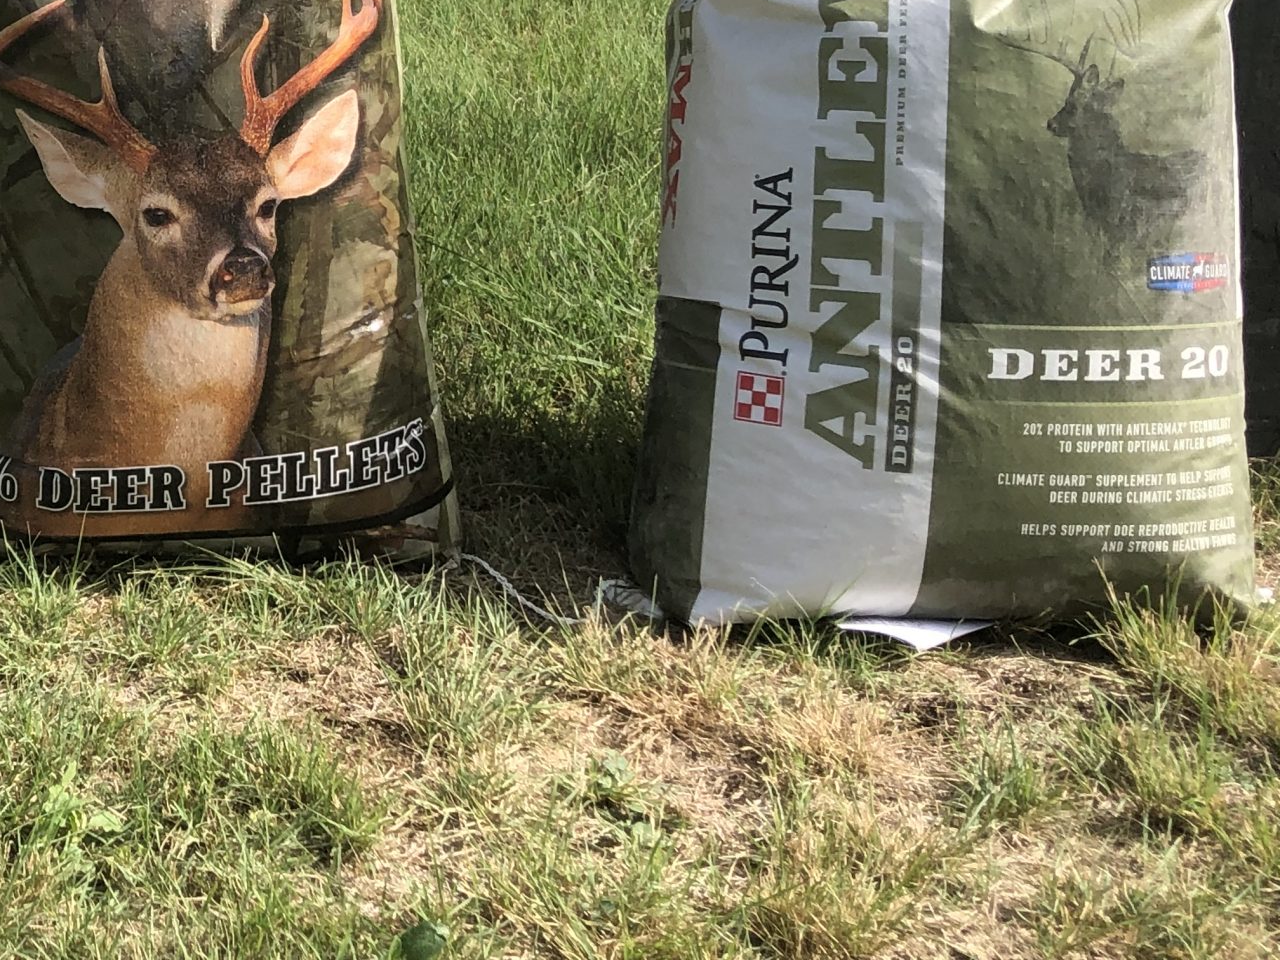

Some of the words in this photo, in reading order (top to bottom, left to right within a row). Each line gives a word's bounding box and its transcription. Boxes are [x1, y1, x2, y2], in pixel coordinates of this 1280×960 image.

[898, 35, 907, 80] DEER
[896, 87, 906, 166] PREMIUM
[739, 167, 799, 362] PURINA
[1150, 265, 1191, 280] CLIMATE
[896, 336, 914, 373] 20
[987, 348, 1165, 381] DEER
[1181, 345, 1230, 379] 20
[891, 380, 913, 467] DEER
[1023, 423, 1043, 436] 20%
[1047, 423, 1093, 436] PROTEIN
[1097, 423, 1123, 436] WITH
[1059, 440, 1072, 453] TO
[1076, 440, 1124, 453] SUPPORT
[1127, 440, 1170, 453] OPTIMAL
[1173, 437, 1205, 452] ANTLER
[36, 465, 186, 512] DEER
[205, 418, 426, 507] PELLETS
[997, 473, 1045, 486] CLIMATE
[1095, 474, 1163, 487] SUPPLEMENT
[1166, 472, 1177, 485] TO
[1180, 470, 1201, 484] HELP
[1049, 491, 1078, 504] DEER
[1081, 491, 1123, 504] DURING
[1126, 490, 1172, 504] CLIMATIC
[1175, 487, 1207, 501] STRESS
[1020, 523, 1057, 536] HELPS
[1060, 524, 1111, 537] SUPPORT
[1113, 524, 1135, 537] DOE
[1138, 520, 1208, 537] REPRODUCTIVE
[1101, 541, 1124, 553] AND
[1127, 540, 1169, 553] STRONG
